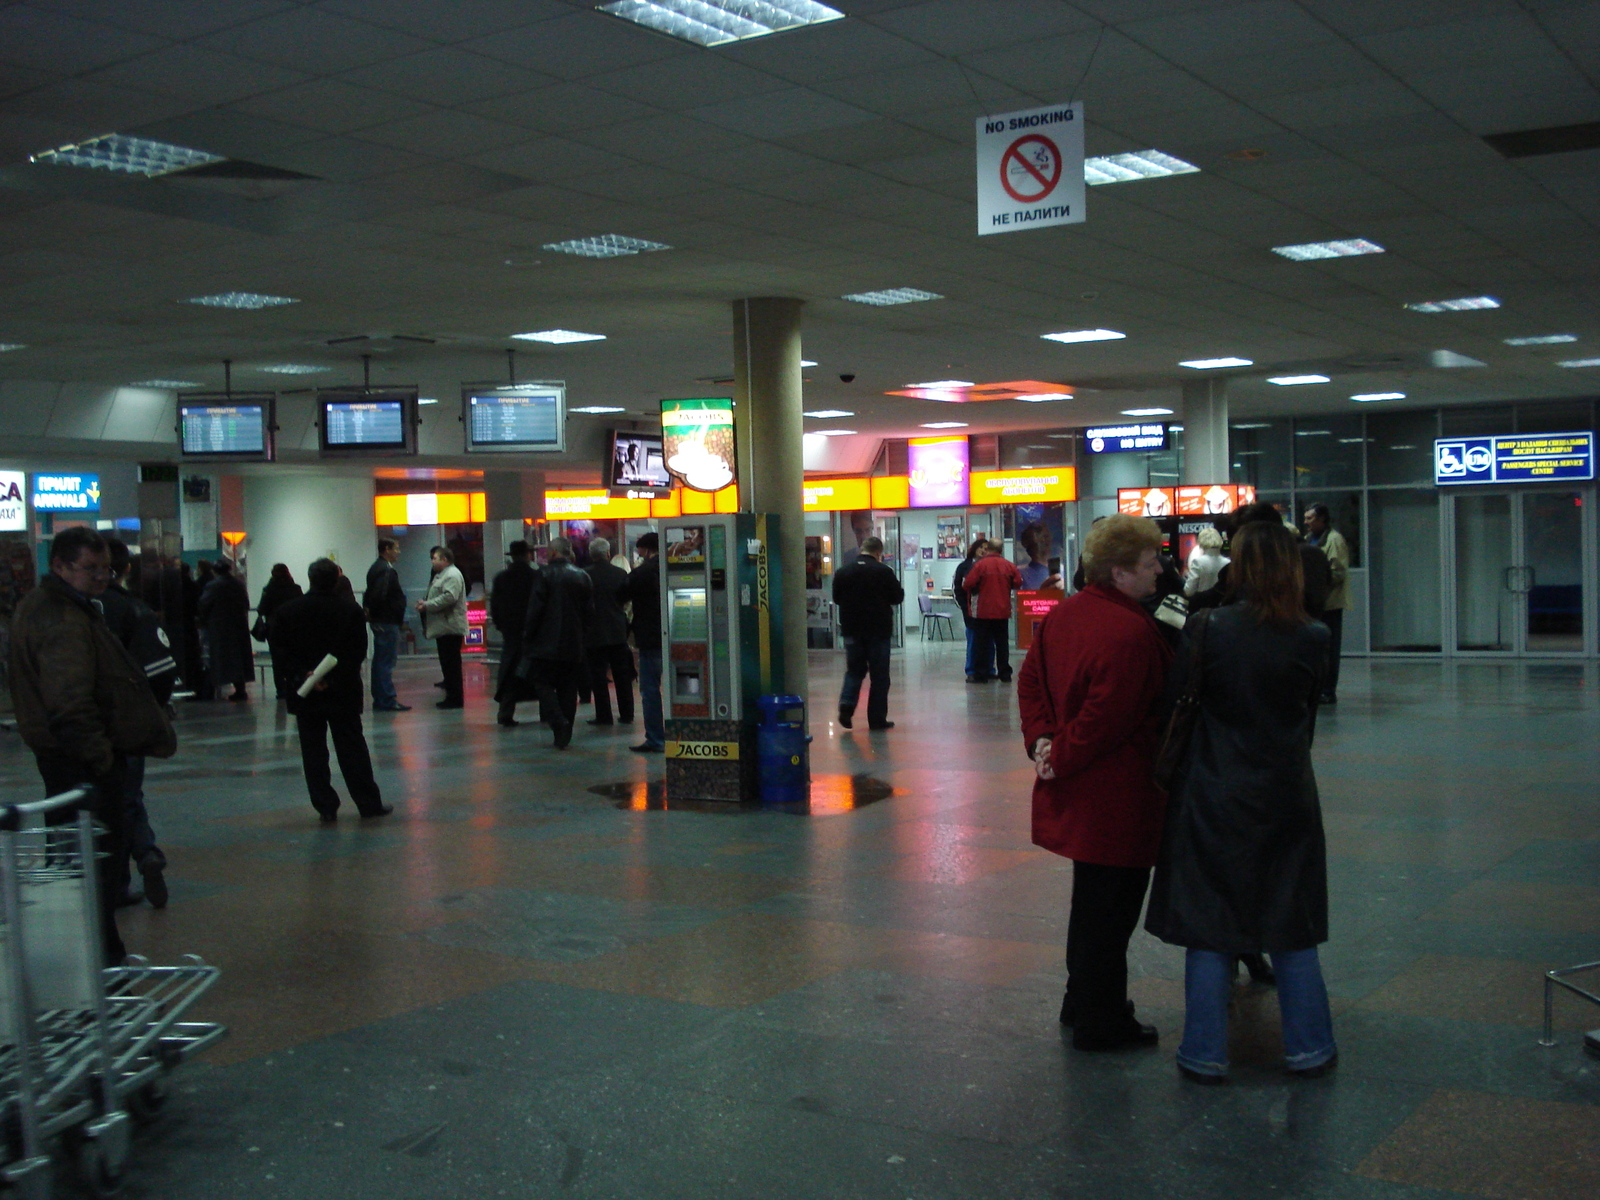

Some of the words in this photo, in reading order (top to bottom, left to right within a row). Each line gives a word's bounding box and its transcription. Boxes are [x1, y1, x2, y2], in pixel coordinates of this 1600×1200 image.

[985, 120, 1004, 134] NO
[1009, 110, 1073, 129] SMOKING
[992, 212, 1010, 226] НЕ
[1014, 205, 1070, 222] ПАЛИТИ
[678, 413, 725, 421] JACOBS
[34, 493, 88, 508] ARRIVALS
[759, 545, 769, 613] JACOBS
[676, 744, 729, 757] JACOBS
